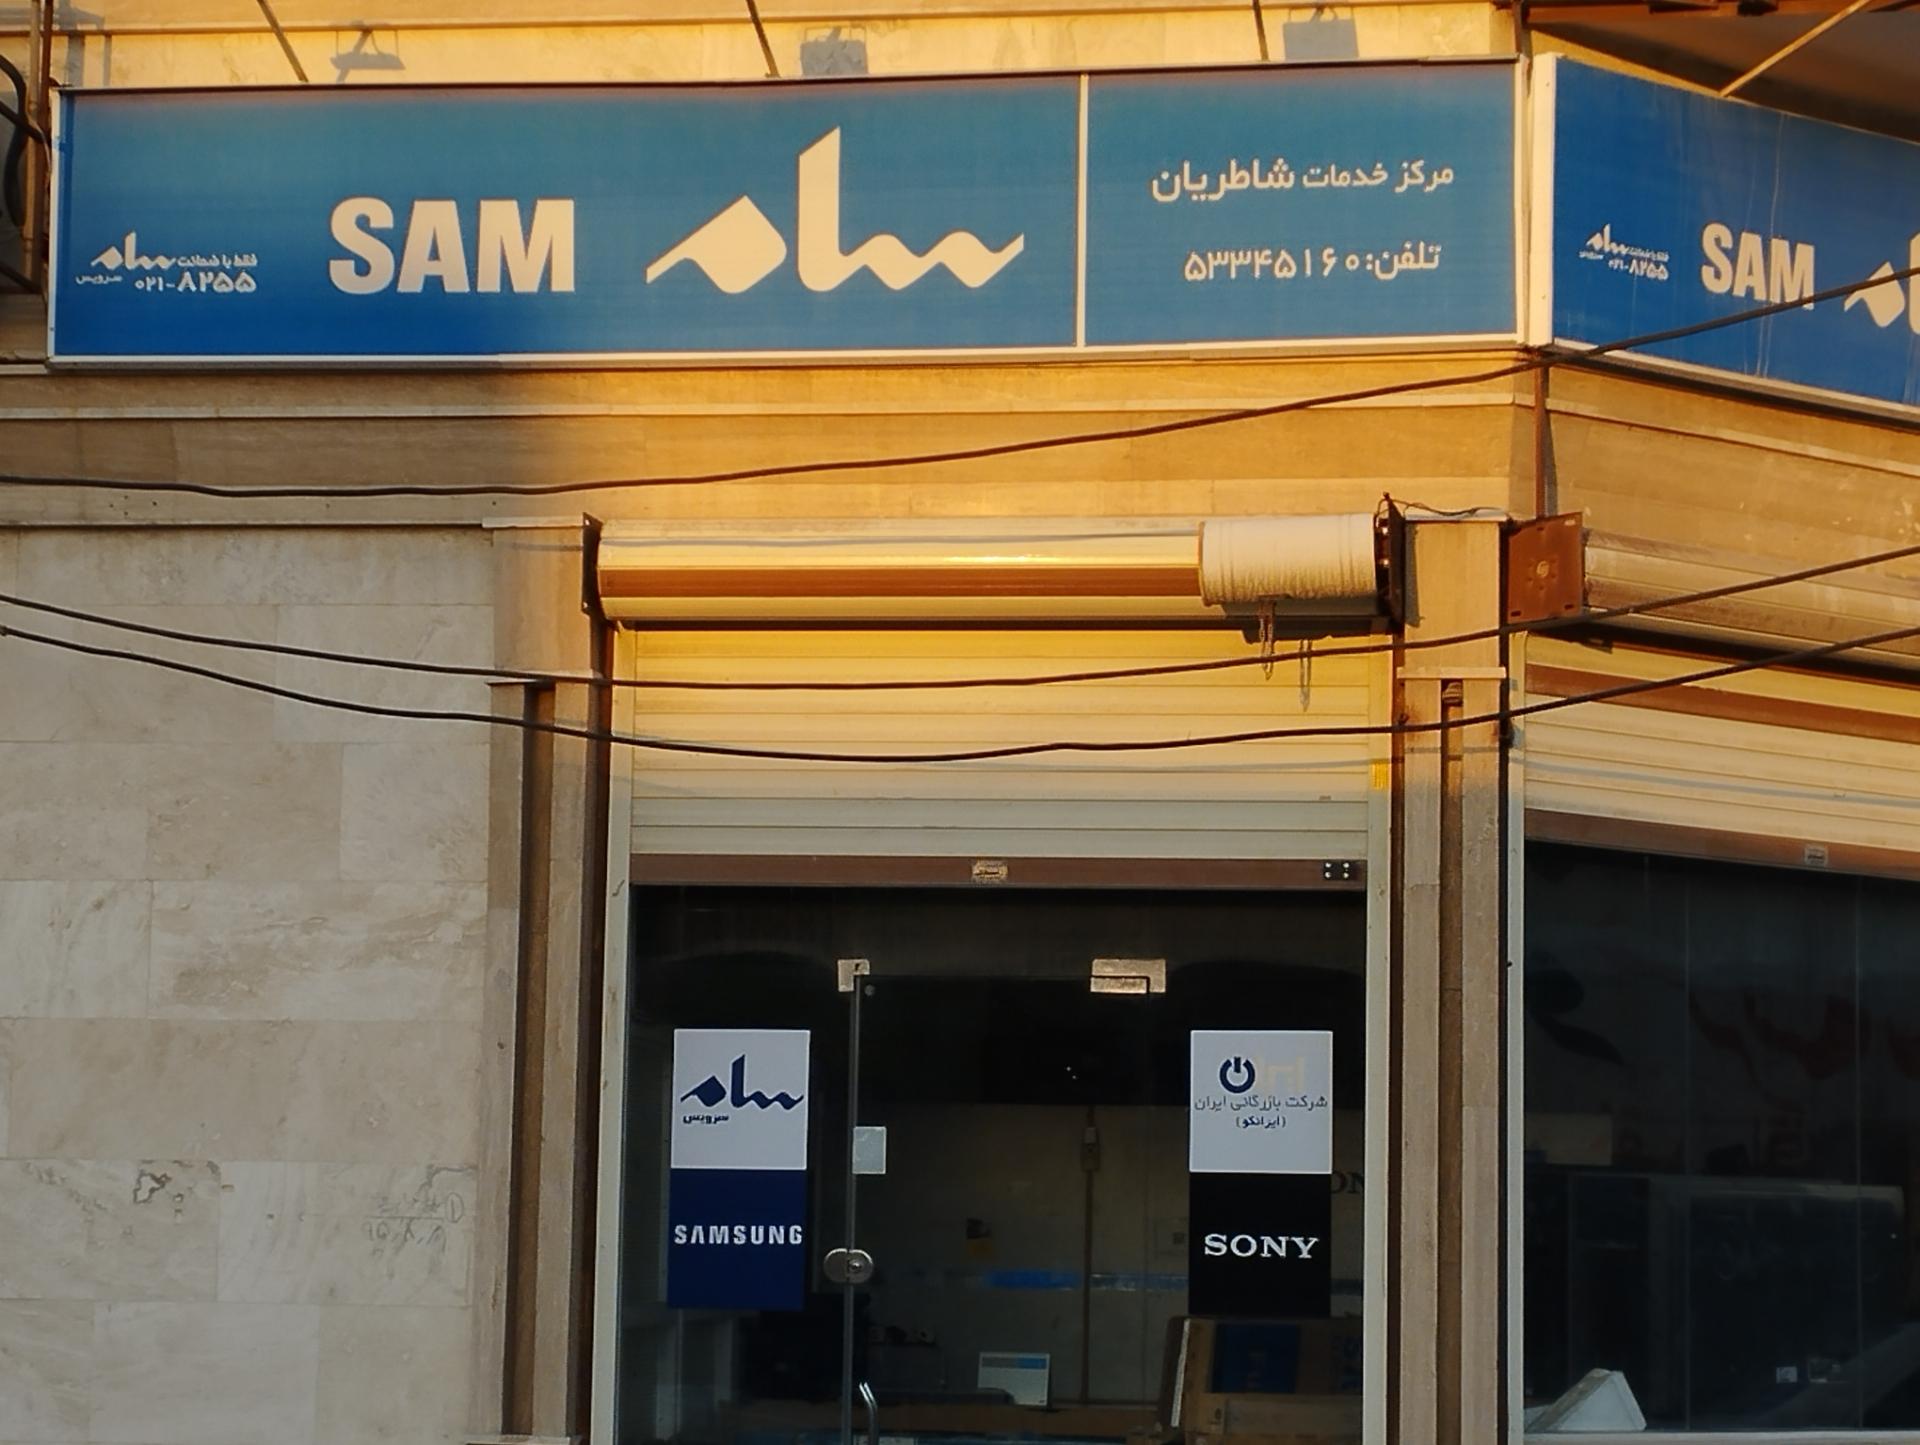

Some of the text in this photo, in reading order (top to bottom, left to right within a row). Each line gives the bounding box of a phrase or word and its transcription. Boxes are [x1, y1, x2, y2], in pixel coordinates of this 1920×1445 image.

[1151, 157, 1454, 203] مرکز خدمات شاطریان
[646, 125, 1024, 294] سام
[328, 197, 575, 295] SAM
[1700, 222, 1815, 311] SAM
[680, 1054, 804, 1110] سام
[1194, 1095, 1328, 1112] شرکت بازرگانی ایران
[682, 1113, 729, 1124] سرویس
[673, 1224, 803, 1245] SAMSUNG
[1204, 1233, 1320, 1259] SONY
